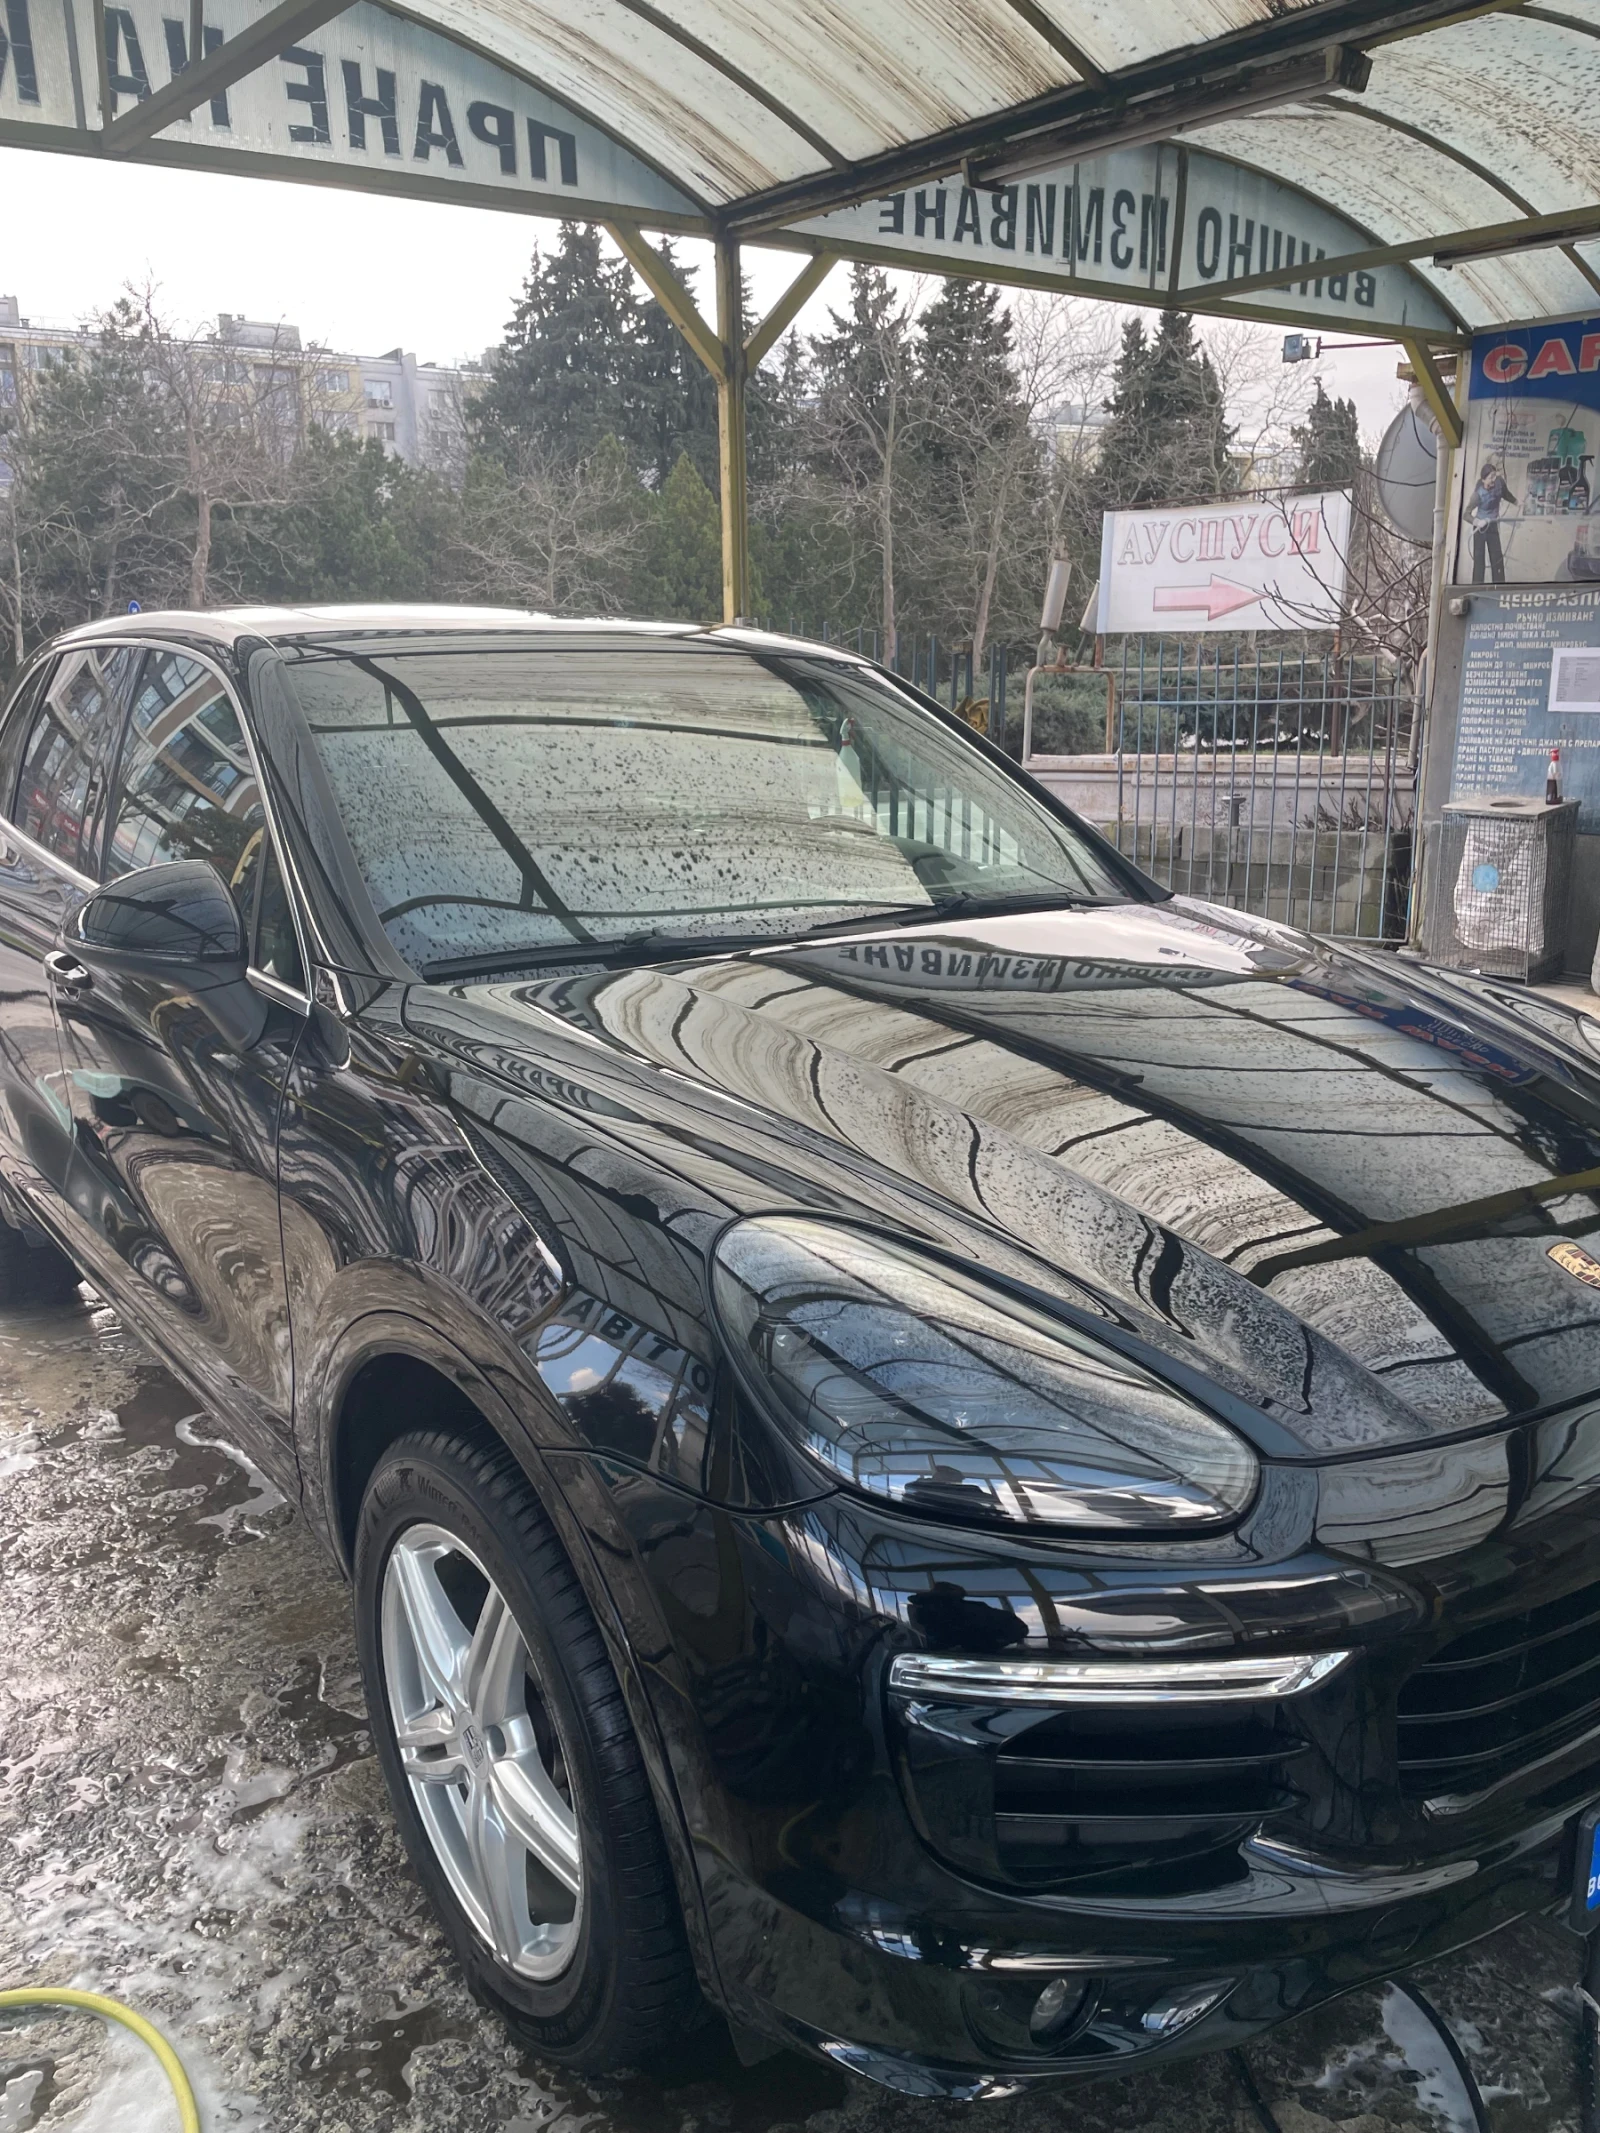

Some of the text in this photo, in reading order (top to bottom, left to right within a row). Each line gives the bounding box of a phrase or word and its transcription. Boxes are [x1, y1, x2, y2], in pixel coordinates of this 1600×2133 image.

[1117, 509, 1322, 565] АУСПУСИ
[1517, 611, 1594, 622] РЪЧНО ИЗМИВАНЕ
[1505, 622, 1546, 631] ПОЧИСТВАНЕ
[1541, 630, 1560, 638] КОЛА
[1510, 679, 1542, 687] ДВИГАТЕЛ
[1464, 687, 1516, 695] ПРАХОСМУКАЧКА
[1463, 697, 1503, 705] ПОЧИСТВАНЕ
[1515, 698, 1539, 706] СТЪКЛА
[1462, 707, 1527, 716] ПОЛИРАНЕ НА ТАБЛО
[1461, 717, 1493, 725] ПОЛИРАНЕ
[1460, 726, 1493, 734] ПОЛИРАНЕ
[1494, 727, 1502, 735] НА
[1459, 736, 1492, 744] ИЗМИВАНЕ
[1494, 737, 1503, 745] НА
[1457, 746, 1478, 754] ПРАНЕ
[1457, 754, 1478, 763] ПРАНЕ
[1478, 755, 1487, 763] НА
[1456, 764, 1518, 773] ПРАНЕ НА СЕДАЛКИ
[1455, 773, 1475, 781] ПРАНЕ
